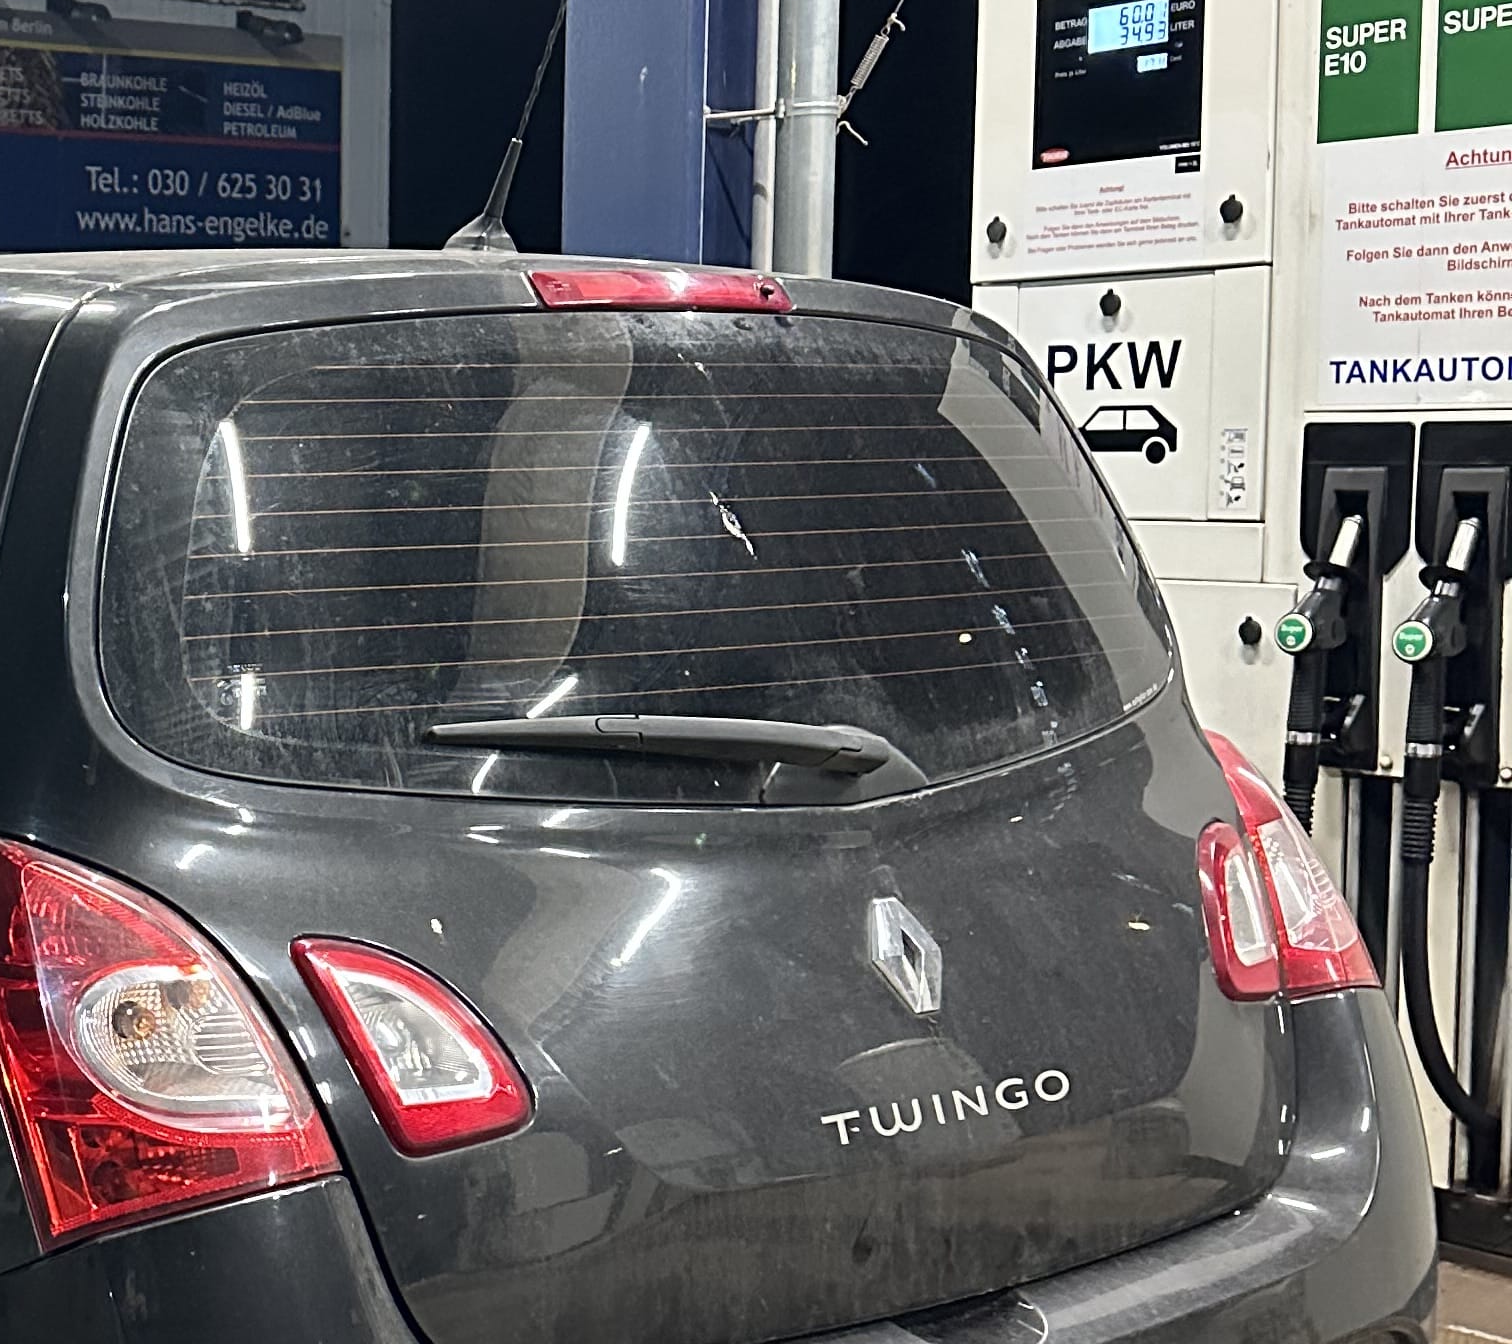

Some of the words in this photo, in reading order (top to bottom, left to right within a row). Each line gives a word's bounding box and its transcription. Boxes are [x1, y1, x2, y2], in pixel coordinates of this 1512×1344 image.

[1171, 0, 1196, 13] EURO
[12, 17, 53, 35] Berlin
[1170, 19, 1195, 32] LITER
[1325, 17, 1407, 50] SUPER
[1324, 50, 1367, 77] E10
[81, 72, 168, 93] BRAUNKOHLE
[224, 80, 267, 99] HEIZÖL
[81, 93, 160, 112] STEINKOHLE
[224, 101, 264, 118] DIESEL
[277, 106, 321, 122] AdBlue
[81, 113, 158, 131] HOLZKOHLE
[224, 122, 297, 139] PETROLEUM
[85, 166, 138, 194] Tel.:
[148, 169, 189, 196] 030
[217, 172, 256, 199] 625
[265, 175, 291, 201] 30
[299, 176, 322, 203] 31
[1348, 202, 1377, 215] Bitte
[1380, 198, 1435, 213] schalten
[1439, 195, 1460, 208] Sie
[1463, 192, 1505, 206] zuerst
[77, 207, 329, 242] www.hans-engelke.de
[1336, 215, 1416, 231] Tankautomat
[1420, 213, 1440, 226] mit
[1444, 210, 1476, 223] Ihrer
[1346, 248, 1389, 263] Folgen
[1392, 247, 1413, 259] Sie
[1417, 244, 1449, 257] dann
[1453, 242, 1477, 255] den
[1359, 295, 1391, 307] Nach
[1395, 294, 1422, 306] dem
[1426, 292, 1473, 305] Tanken
[1373, 309, 1455, 323] Tankautomat
[1459, 307, 1493, 320] Ihren
[1047, 340, 1182, 390] PKW
[1330, 356, 1512, 384] TANKAUTO
[820, 1069, 1070, 1145] TWINGO
